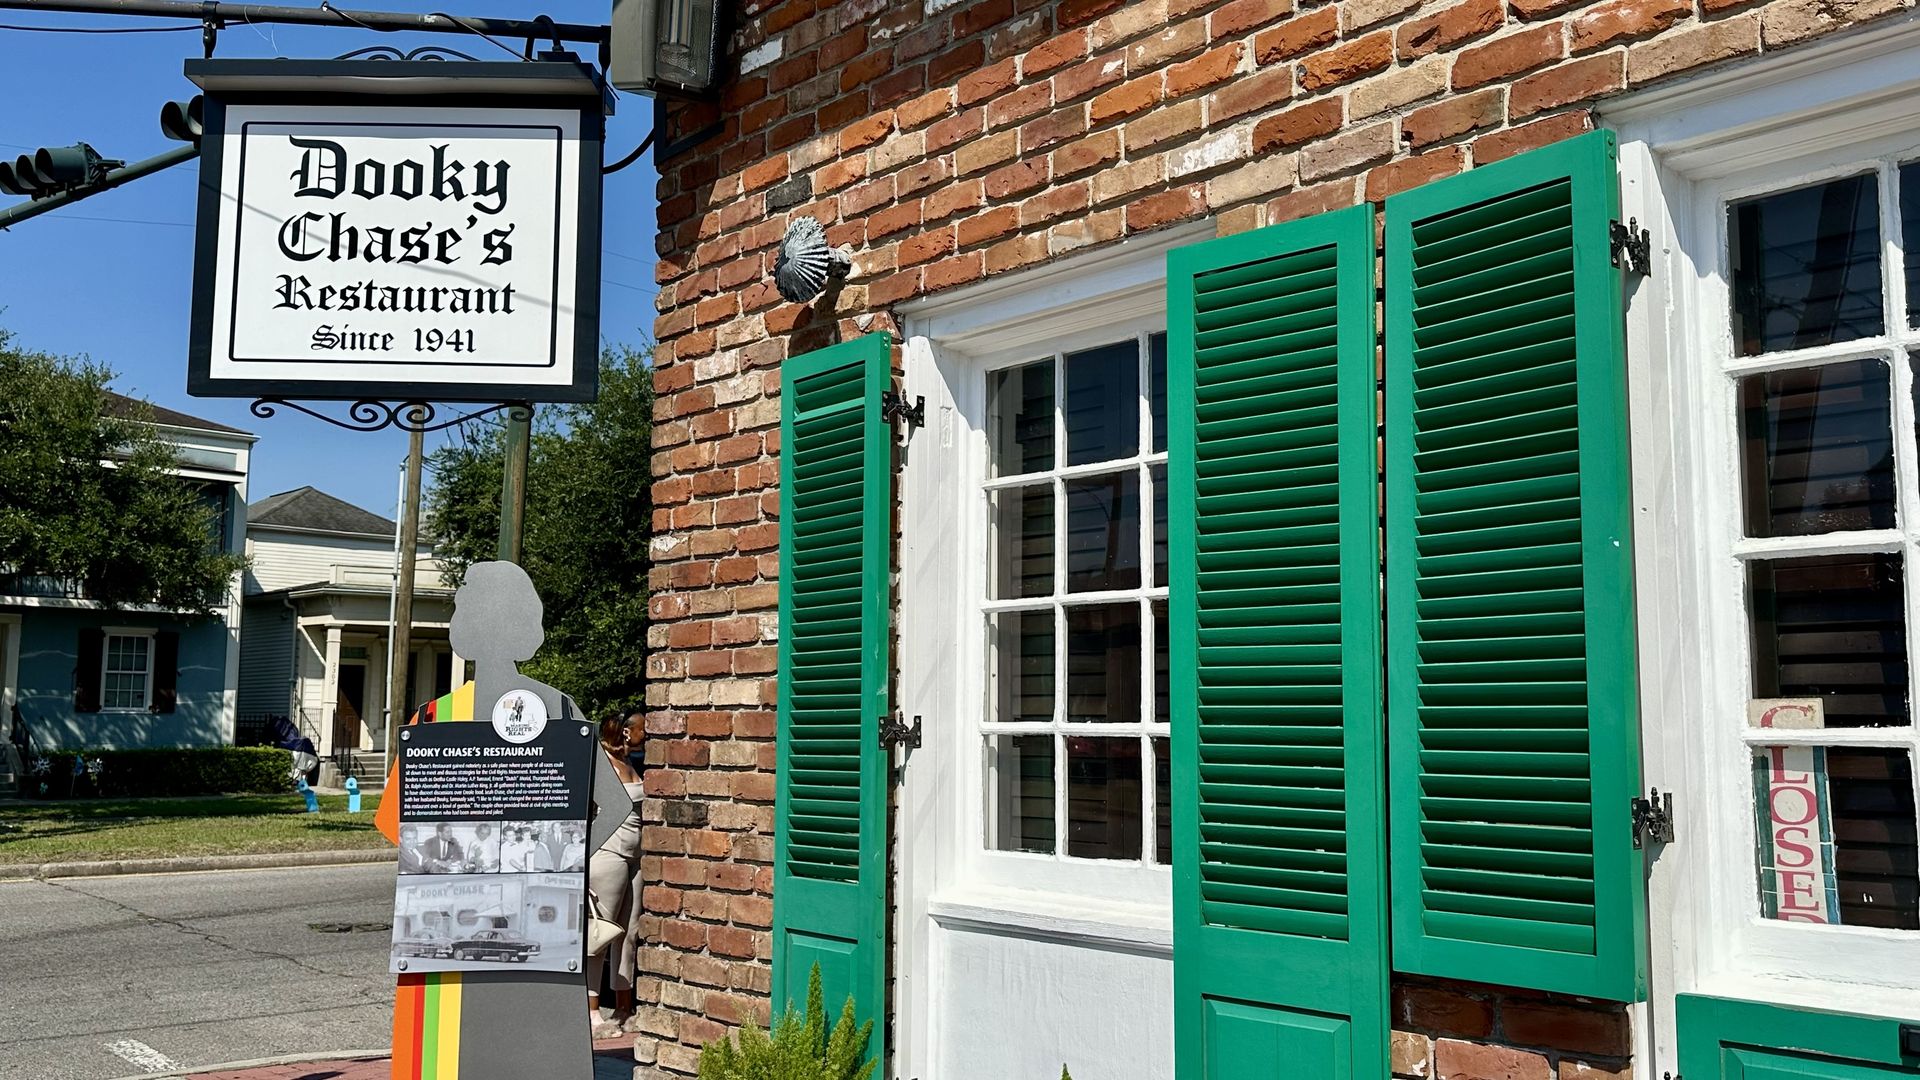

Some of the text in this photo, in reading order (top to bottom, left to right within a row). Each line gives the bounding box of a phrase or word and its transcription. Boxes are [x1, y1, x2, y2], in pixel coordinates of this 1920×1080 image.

[289, 134, 511, 215] Dooky
[278, 210, 515, 265] Chase's
[273, 275, 515, 314] Restaurant
[311, 324, 476, 353] Since 1941
[407, 747, 543, 757] DOOKY CHASE'S RESTAURANT
[1761, 705, 1826, 923] CLOSE
[453, 886, 484, 896] CHASE
